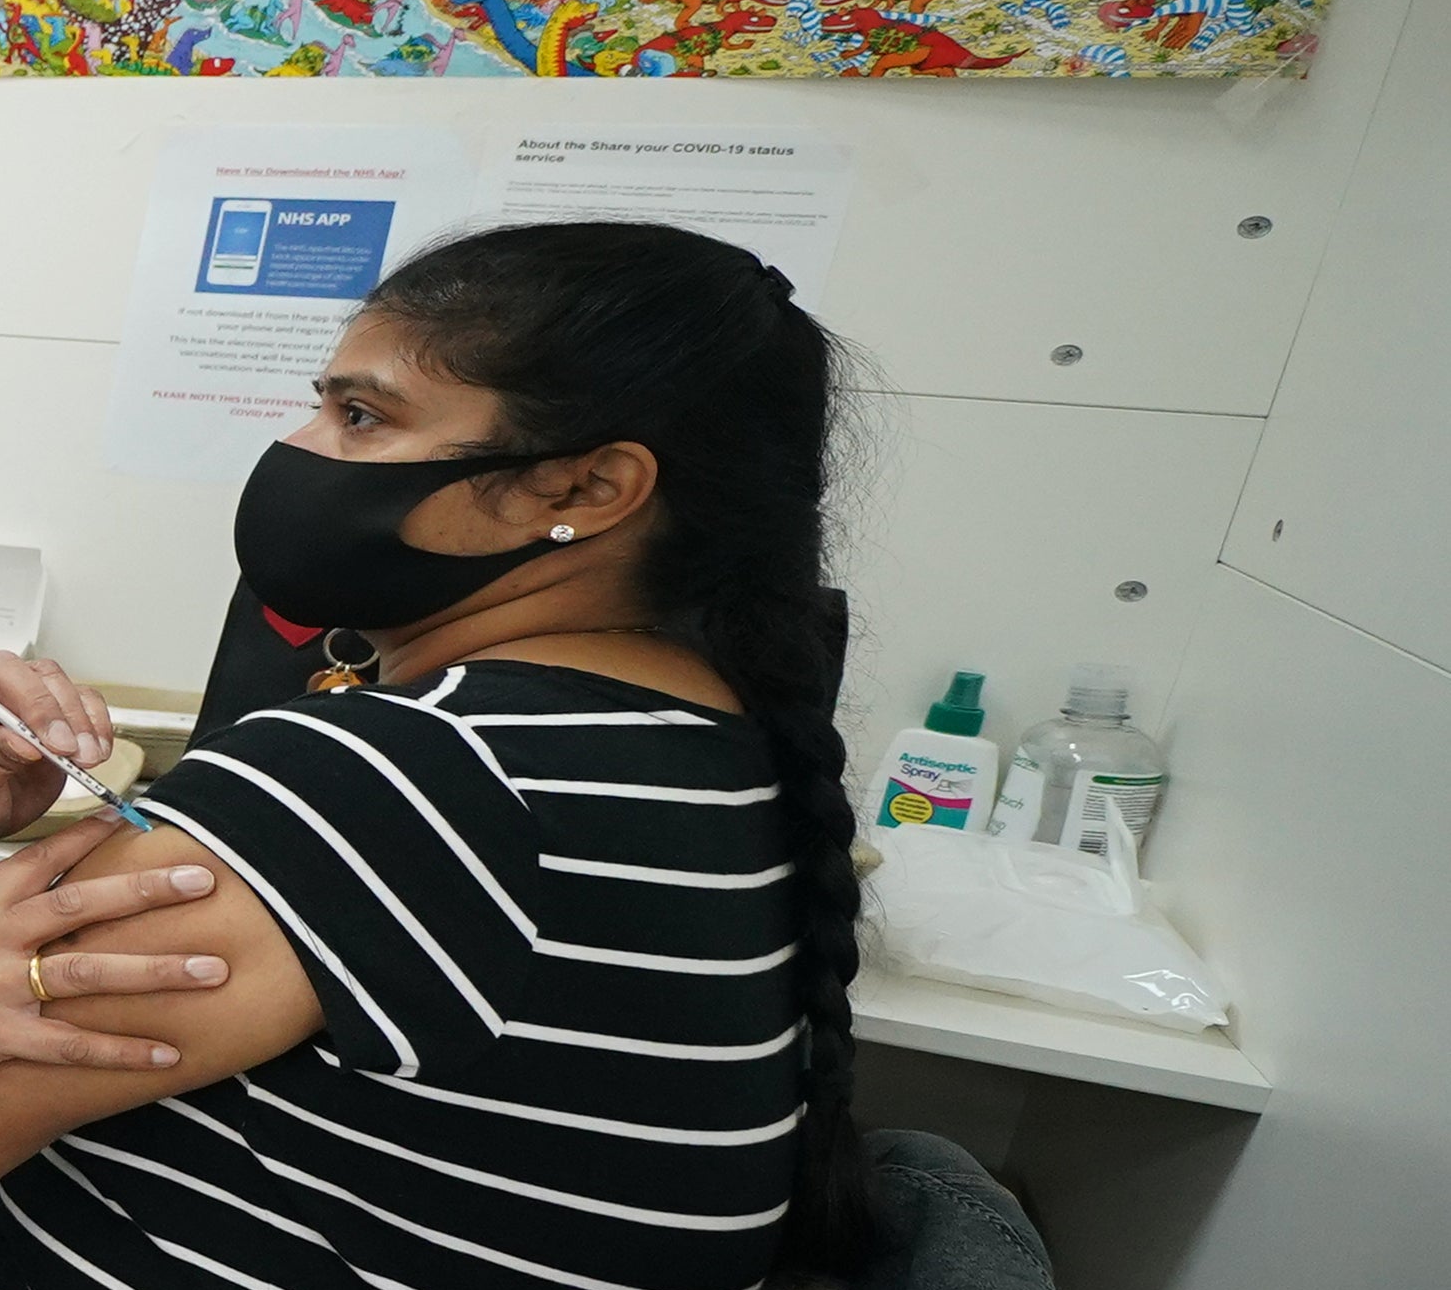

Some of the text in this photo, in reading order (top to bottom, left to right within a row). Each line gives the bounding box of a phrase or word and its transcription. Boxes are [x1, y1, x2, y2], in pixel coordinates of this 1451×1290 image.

[518, 139, 794, 156] About the Share your COVID-19 status
[515, 153, 565, 163] service
[216, 167, 240, 177] Have
[244, 167, 263, 177] You
[265, 167, 330, 177] Downloaded
[334, 168, 350, 178] the
[353, 168, 375, 178] NHS
[277, 212, 352, 227] NHS APP
[206, 310, 254, 318] download
[265, 312, 289, 320] from
[291, 313, 309, 321] the
[241, 325, 273, 334] phone
[152, 390, 187, 400] PLEASE
[189, 393, 216, 402] NOTE
[219, 394, 240, 403] THIS
[230, 408, 285, 419] COVID APP
[899, 752, 977, 775] Antiseptic
[901, 764, 941, 782] Spray
